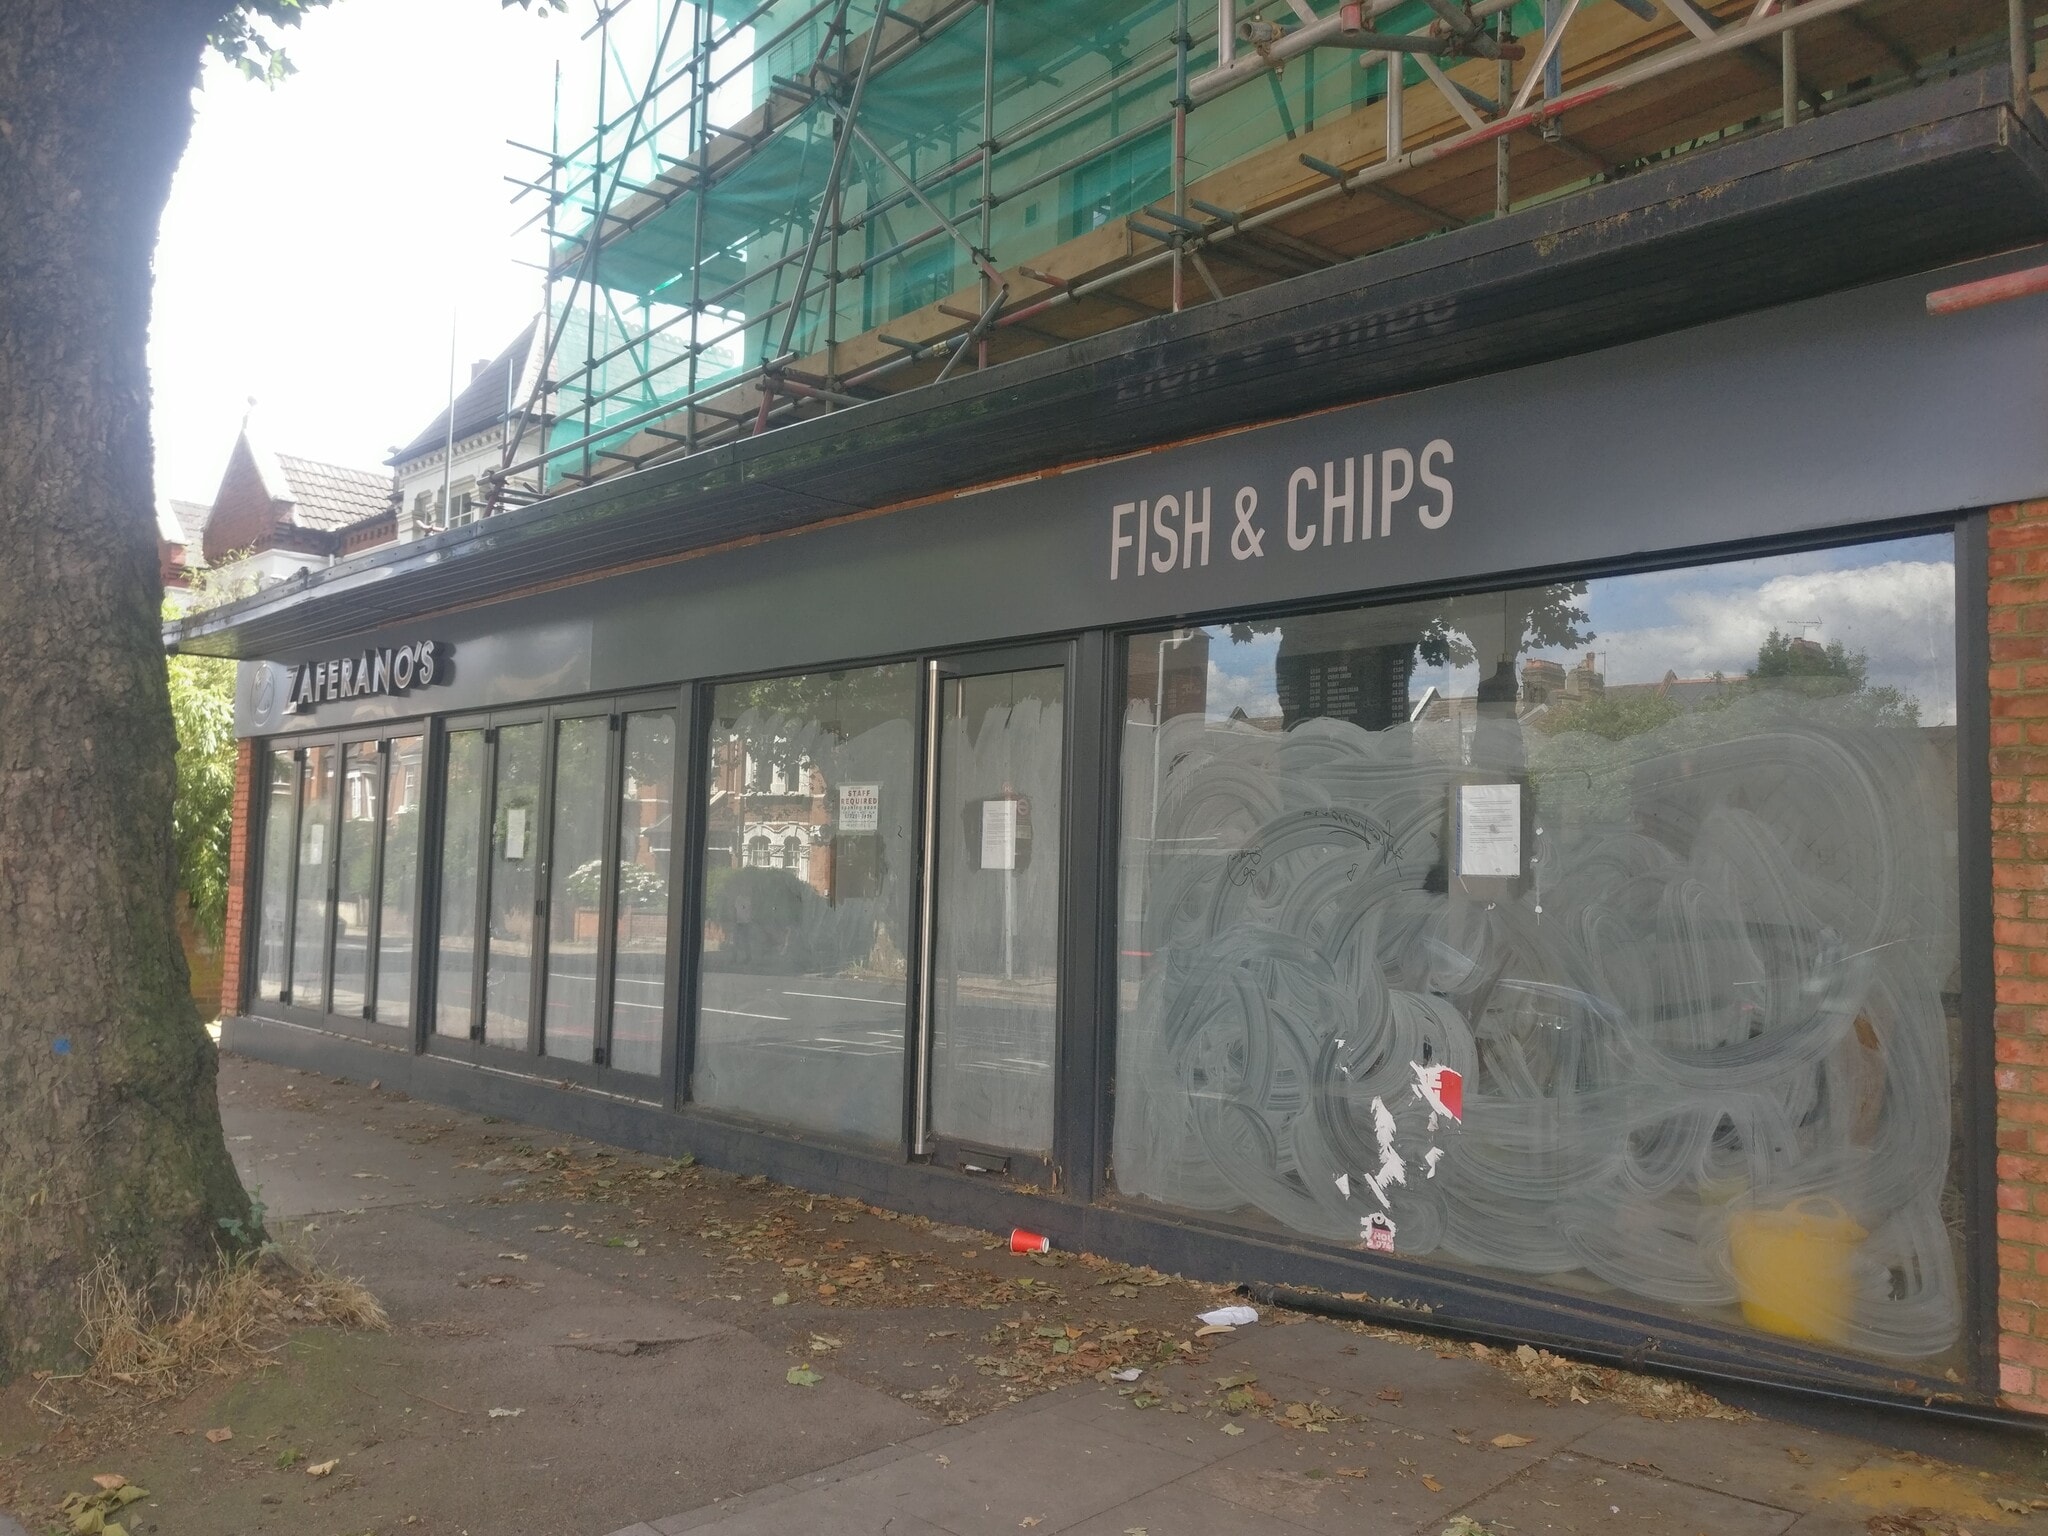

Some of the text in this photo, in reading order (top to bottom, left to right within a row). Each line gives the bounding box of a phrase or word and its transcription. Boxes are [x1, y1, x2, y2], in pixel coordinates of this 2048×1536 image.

[1110, 439, 1454, 581] FISH & CHIPS
[281, 640, 435, 715] ZAFERANO'S
[840, 797, 878, 805] REQUIRED
